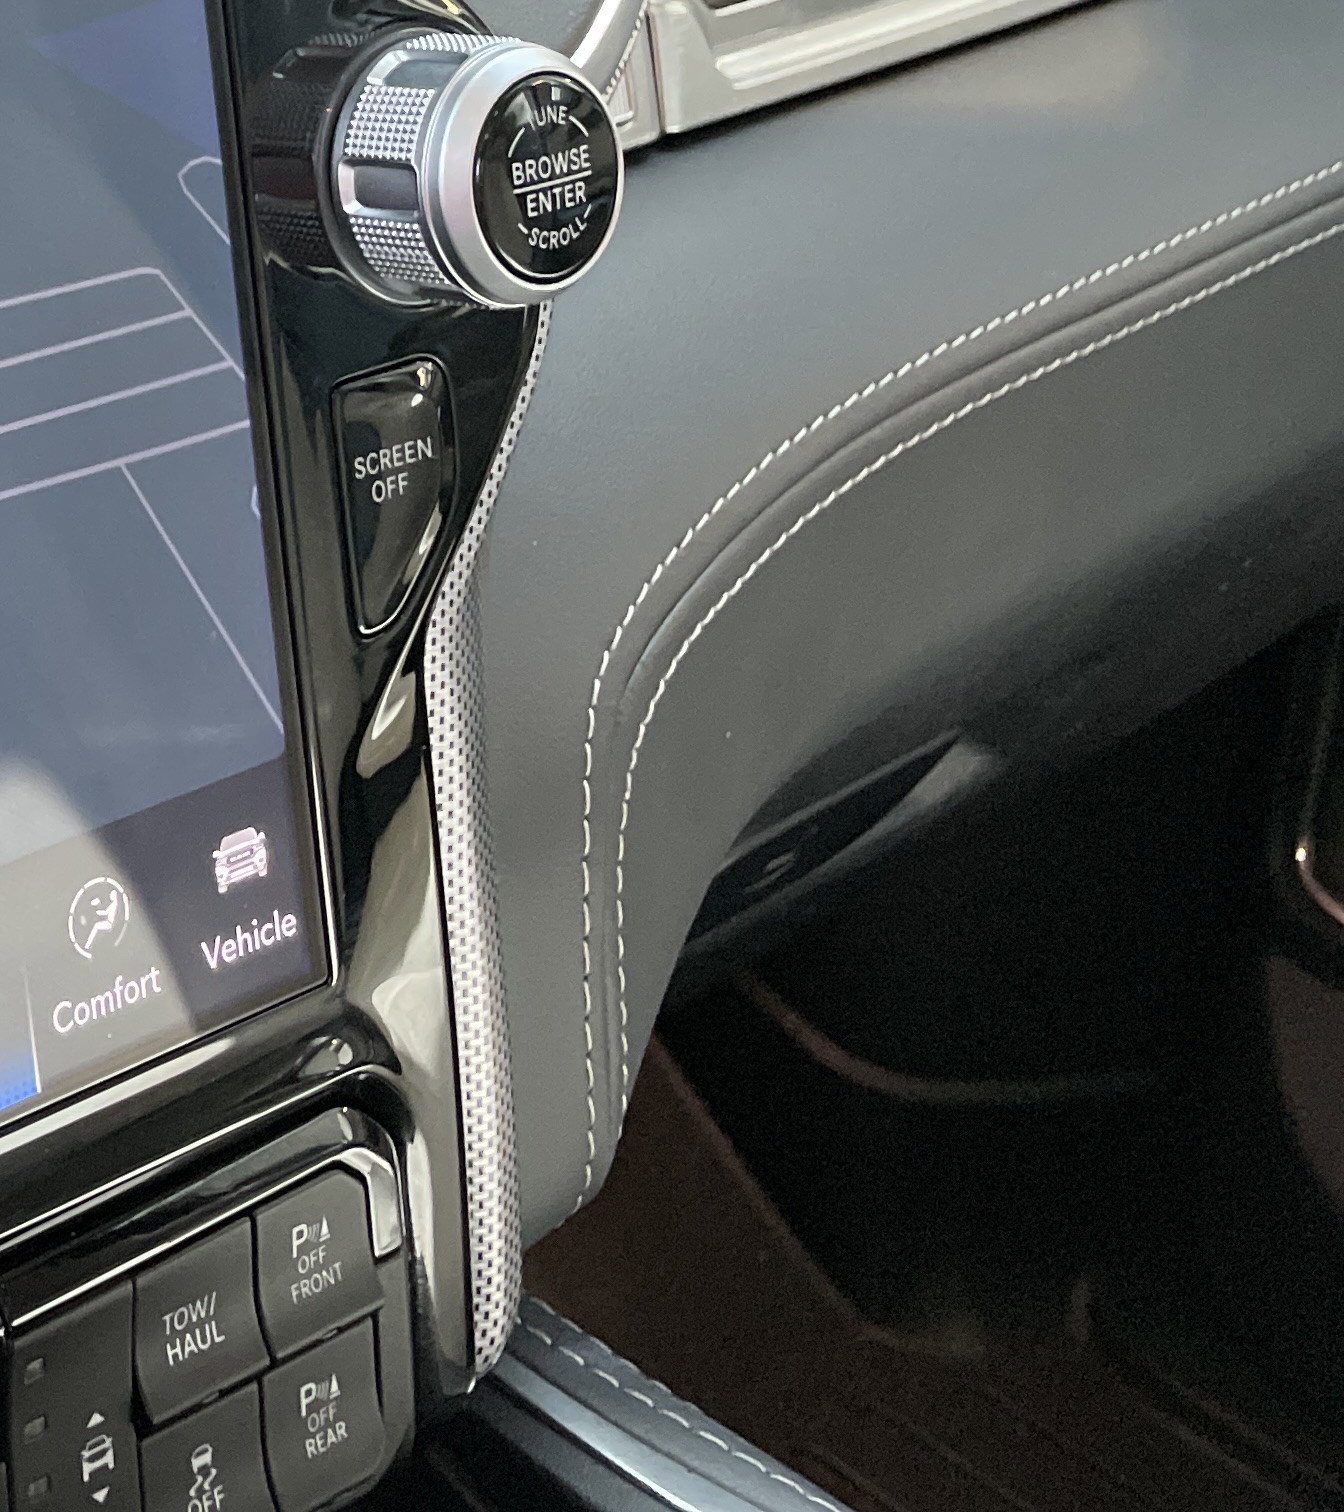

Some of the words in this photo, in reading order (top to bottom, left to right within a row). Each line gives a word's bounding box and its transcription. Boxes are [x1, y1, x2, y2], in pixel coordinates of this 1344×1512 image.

[527, 104, 568, 130] UNE
[512, 144, 592, 186] BROWSE
[526, 180, 587, 218] ENTER
[529, 216, 587, 250] SCROLL
[354, 436, 433, 480] SCREEN
[371, 472, 409, 503] OFF
[200, 909, 298, 970] Vehicle
[52, 967, 162, 1035] Comfort
[297, 1245, 327, 1274] OFF
[291, 1261, 342, 1305] FRONT
[162, 1291, 217, 1335] TOW/
[166, 1320, 225, 1366] HAUL
[308, 1401, 337, 1433] OFF
[305, 1421, 348, 1459] REAR
